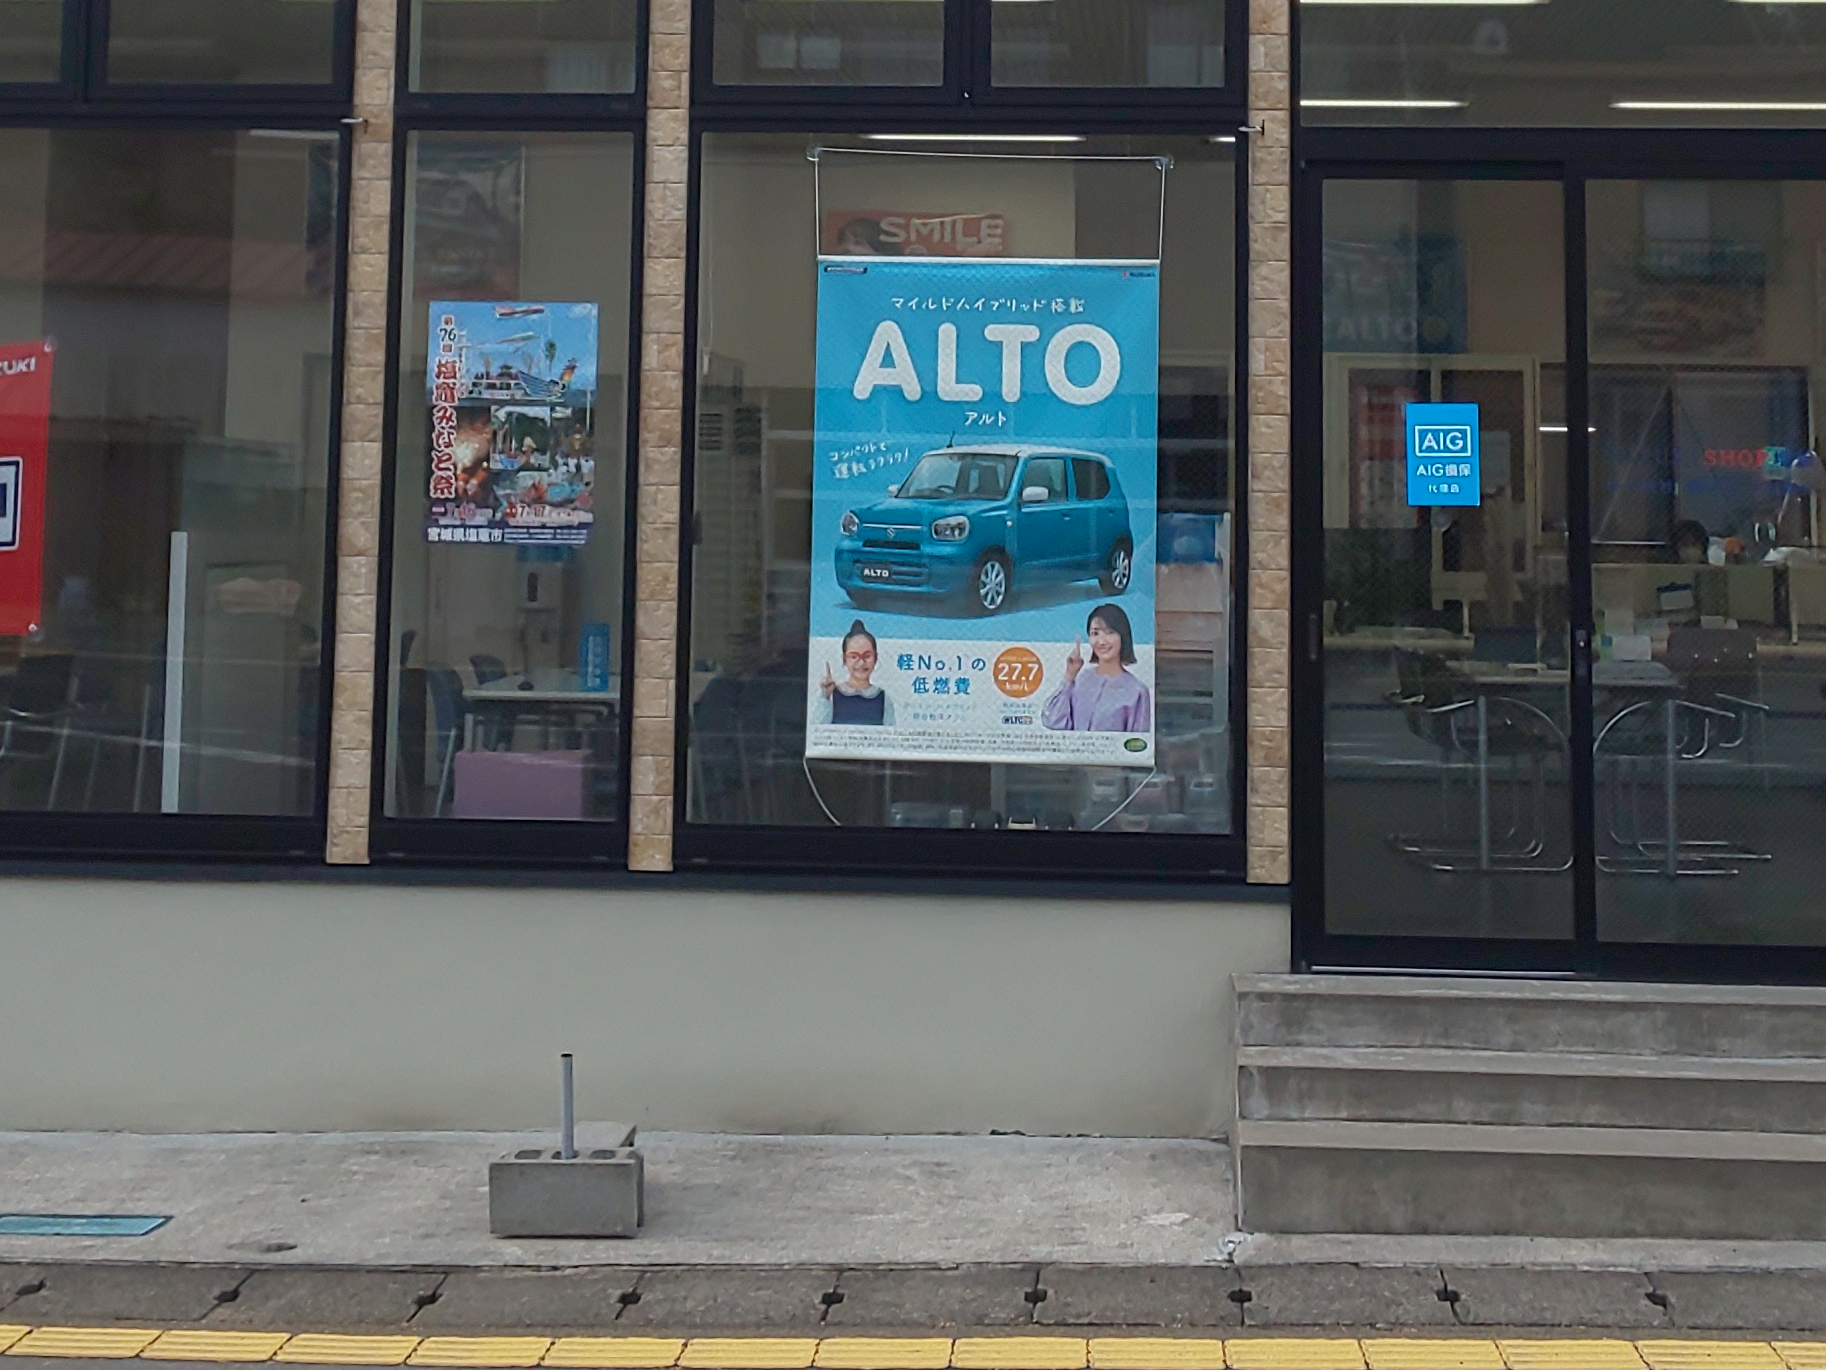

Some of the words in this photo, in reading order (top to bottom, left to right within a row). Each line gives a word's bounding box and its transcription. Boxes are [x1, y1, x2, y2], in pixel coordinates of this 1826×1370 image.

[879, 216, 1004, 251] SMILE
[852, 320, 1121, 406] ALTO
[964, 410, 1007, 427] アルト
[1421, 431, 1464, 451] AIG
[863, 568, 890, 577] ALTO
[896, 653, 987, 672] 軽No.1の
[997, 662, 1040, 681] 27.7
[912, 675, 971, 695] 低燃費
